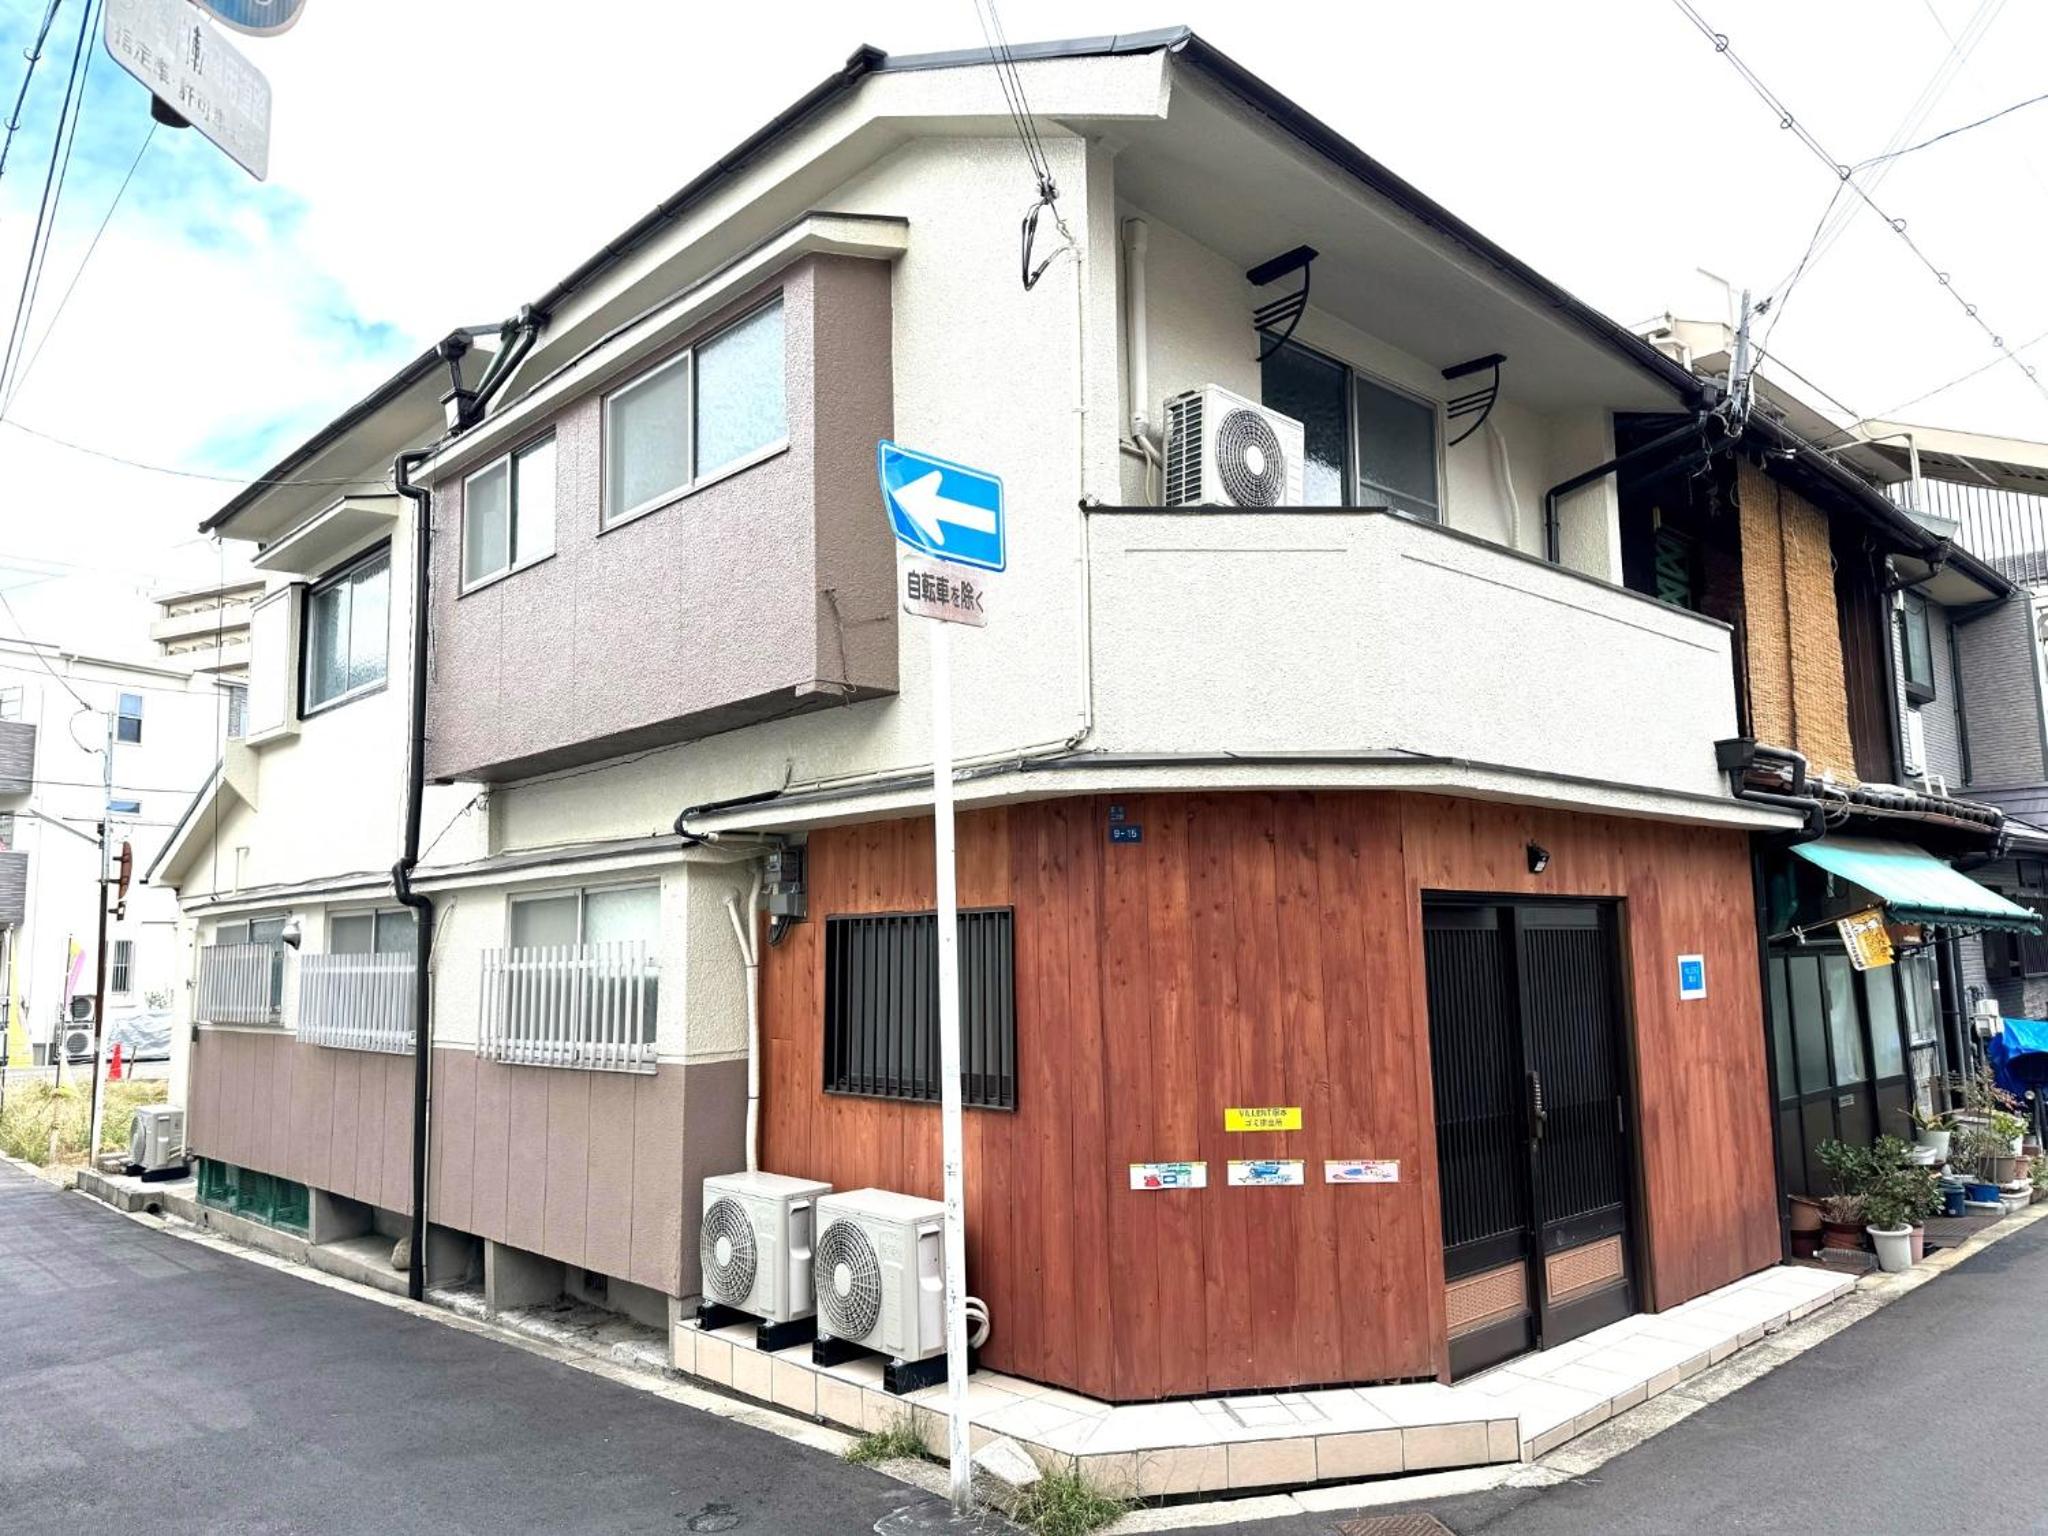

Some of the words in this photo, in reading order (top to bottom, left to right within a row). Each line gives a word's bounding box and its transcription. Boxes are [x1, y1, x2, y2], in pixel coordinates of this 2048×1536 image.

[908, 569, 984, 613] 自転車を除く
